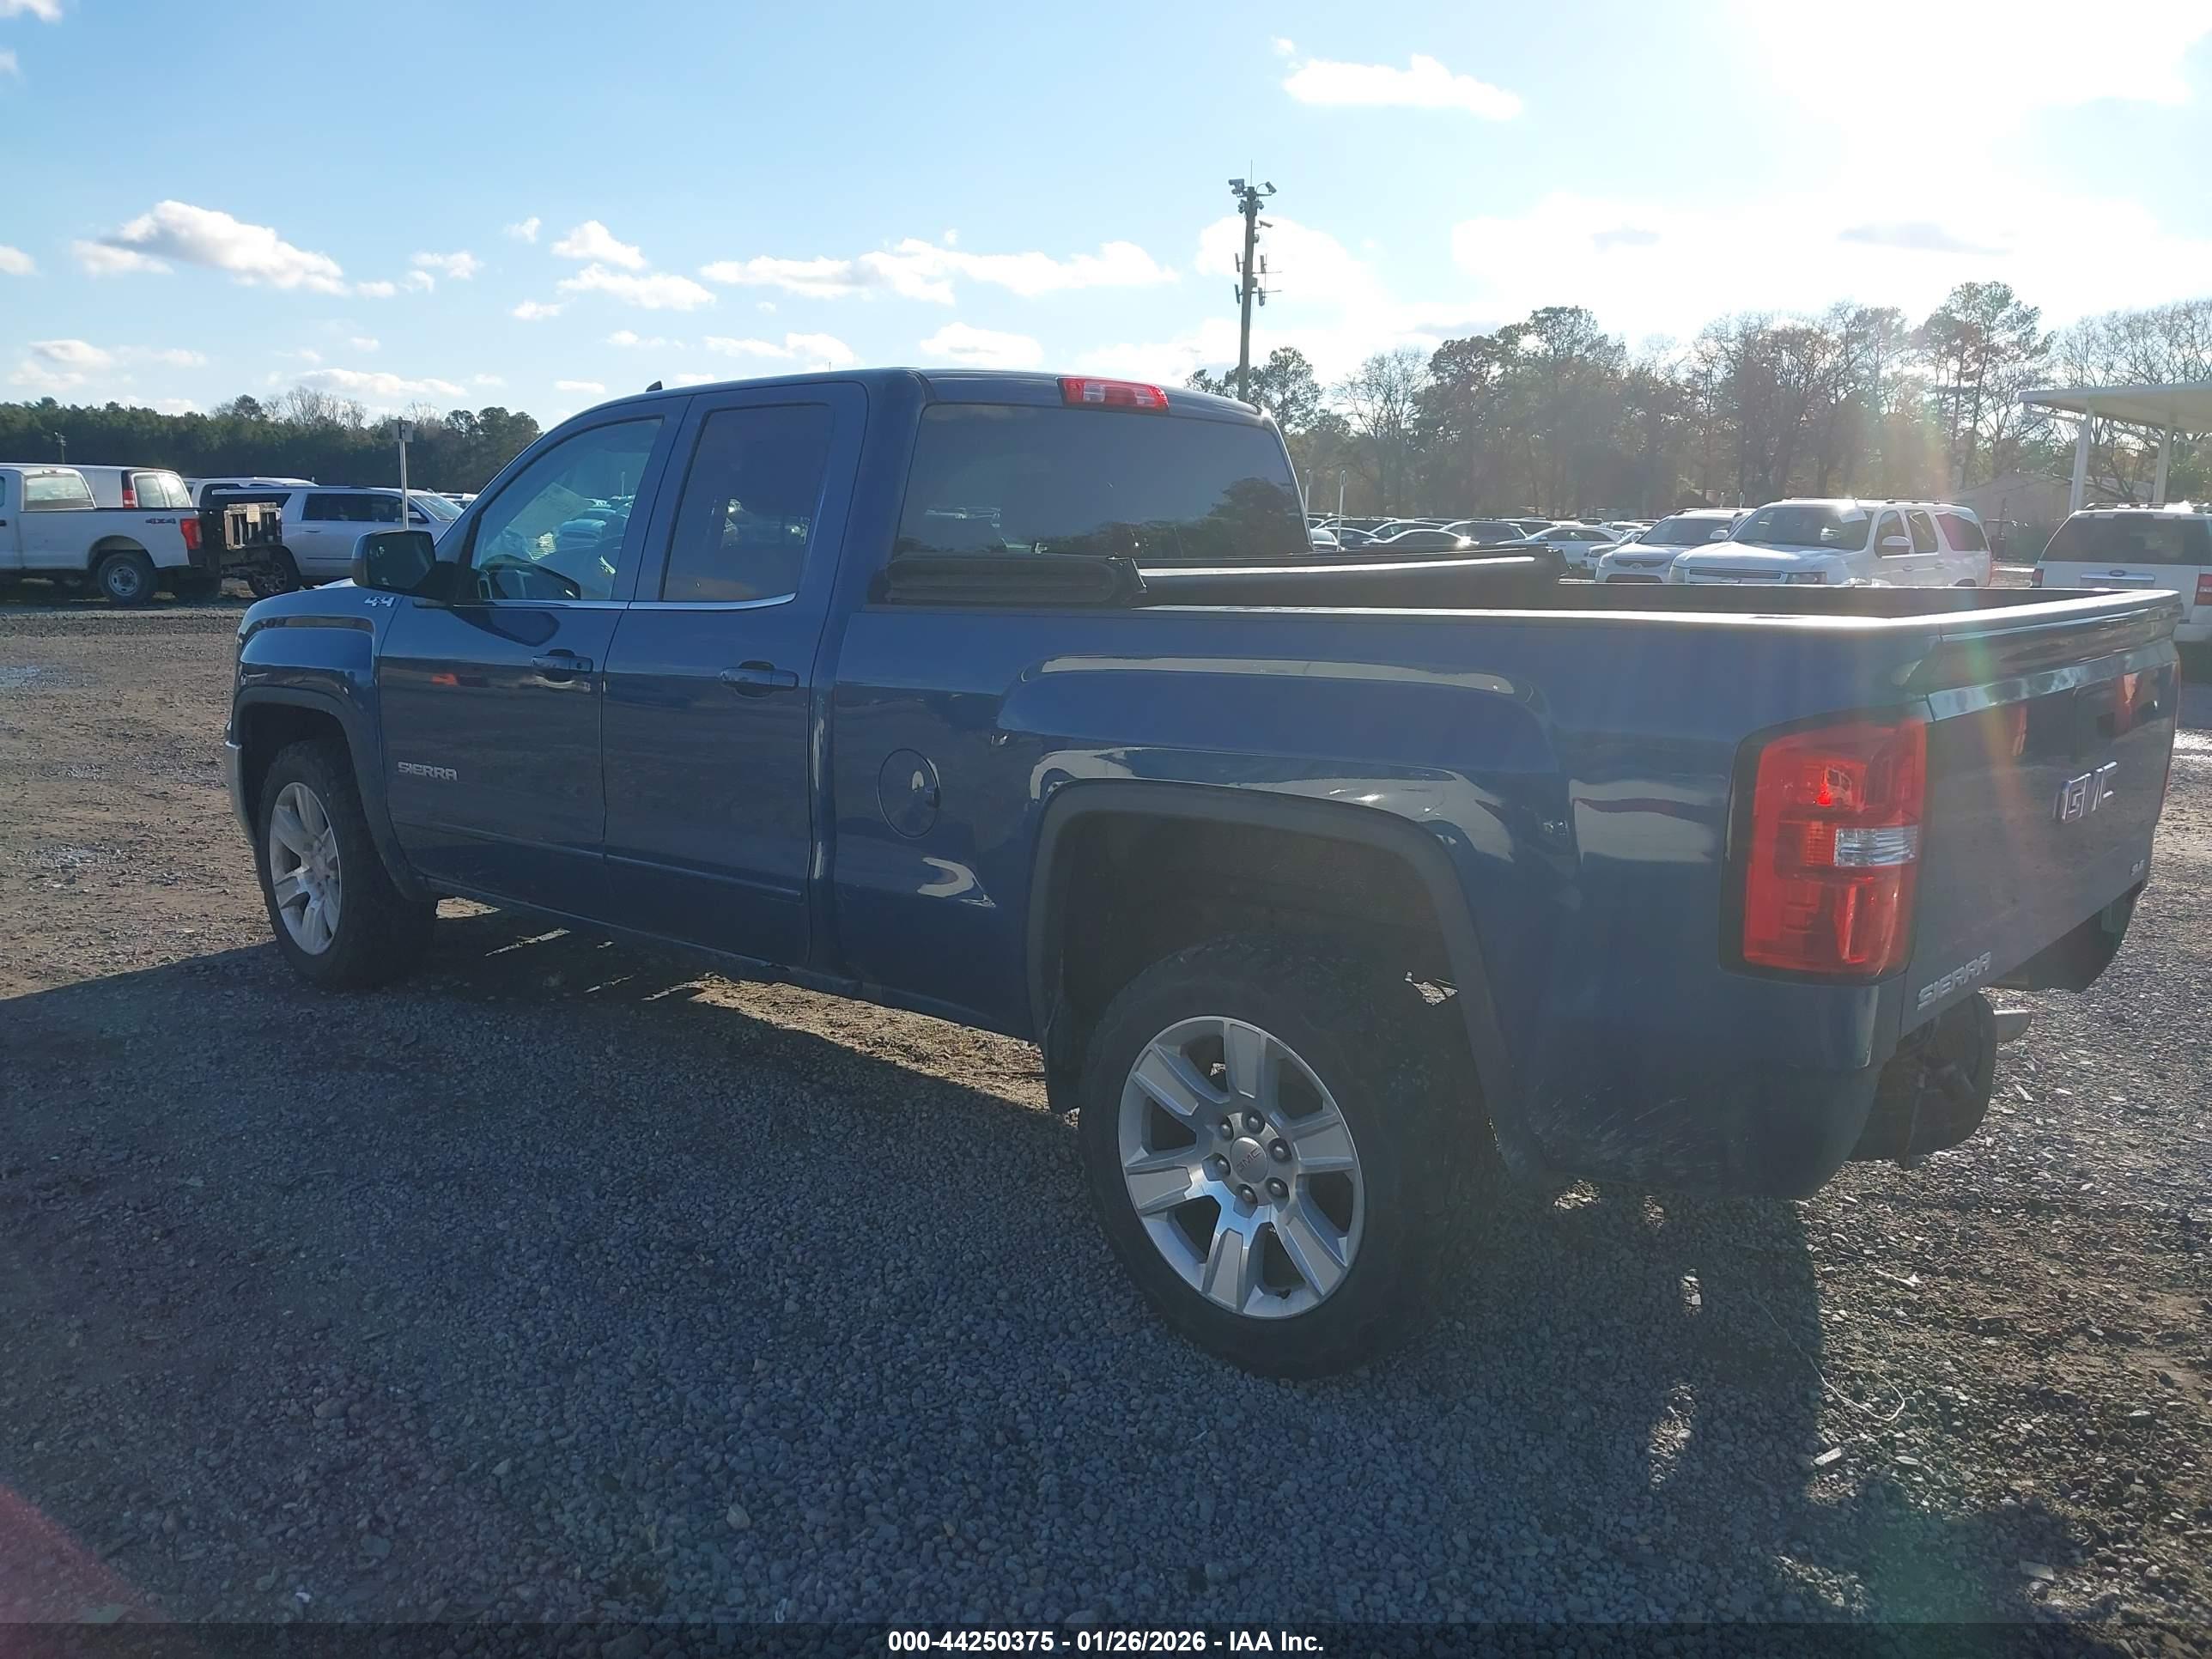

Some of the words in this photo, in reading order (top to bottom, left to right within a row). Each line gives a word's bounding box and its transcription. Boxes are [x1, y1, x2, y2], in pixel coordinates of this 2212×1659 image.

[398, 761, 459, 781] SIERRA
[1917, 951, 1992, 1010] SIERRA
[1237, 1146, 1261, 1173] GMC
